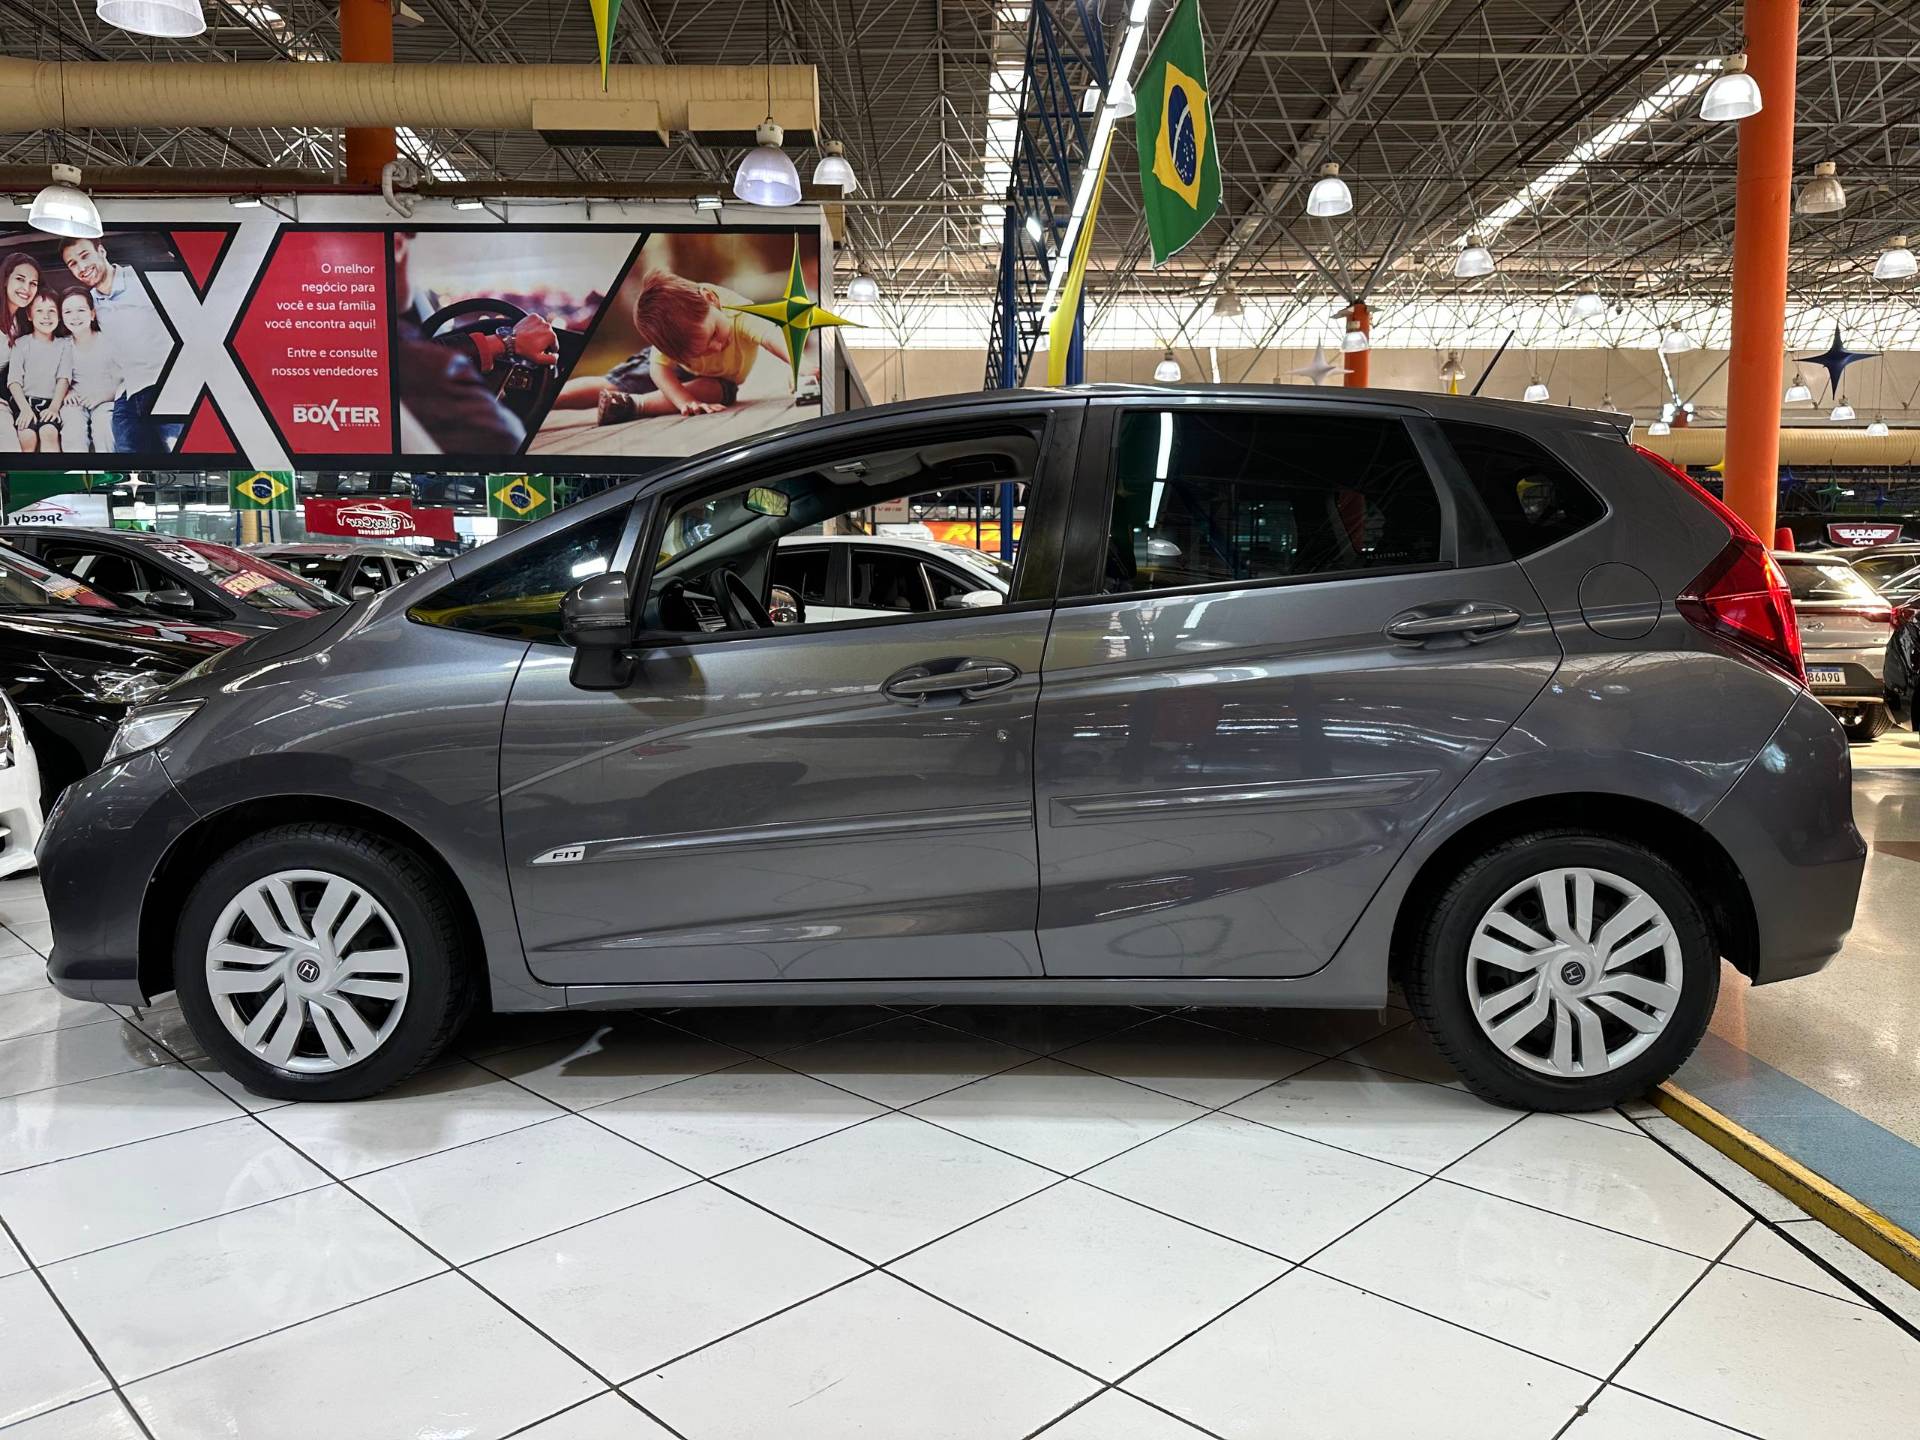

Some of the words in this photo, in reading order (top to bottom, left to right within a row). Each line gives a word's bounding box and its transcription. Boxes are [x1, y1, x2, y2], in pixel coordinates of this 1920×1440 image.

[321, 263, 332, 274] O
[334, 264, 375, 274] melhor
[301, 282, 348, 294] negócio
[350, 284, 375, 294] para
[276, 301, 304, 310] você
[306, 302, 314, 310] e
[316, 302, 336, 310] sua
[338, 300, 376, 310] família
[265, 318, 292, 329] você
[295, 319, 346, 329] encontra
[348, 319, 376, 331] aqui!
[287, 347, 317, 358] Entre
[319, 349, 327, 358] e
[329, 347, 378, 358] consulte
[271, 367, 311, 376] nossos
[312, 365, 378, 376] vendedores
[293, 399, 380, 431] BOXTER
[552, 850, 581, 860] FIT
